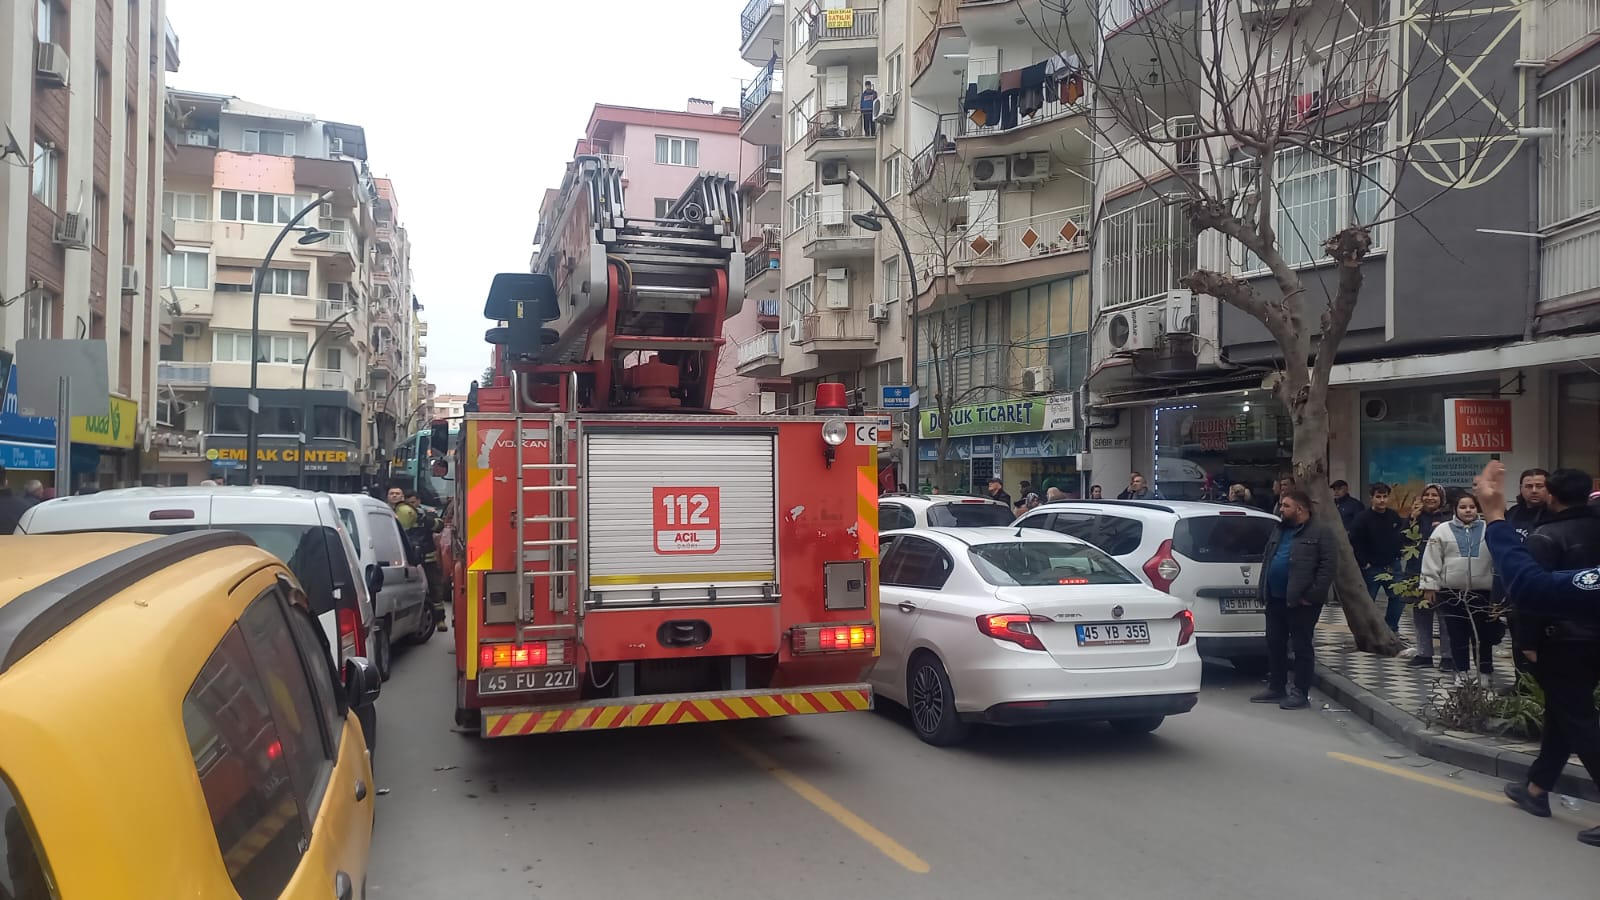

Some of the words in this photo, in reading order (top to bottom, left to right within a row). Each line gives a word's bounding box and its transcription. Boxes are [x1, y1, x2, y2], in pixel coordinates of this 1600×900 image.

[497, 440, 546, 448] VOKAN
[1462, 430, 1505, 448] BAYİSİ
[218, 448, 279, 462] EMAK
[663, 494, 710, 525] 112
[1085, 626, 1099, 640] 45
[1105, 626, 1120, 639] YB
[1126, 625, 1147, 638] 355
[488, 675, 507, 690] 45
[516, 673, 535, 688] FU
[545, 671, 572, 687] 227
